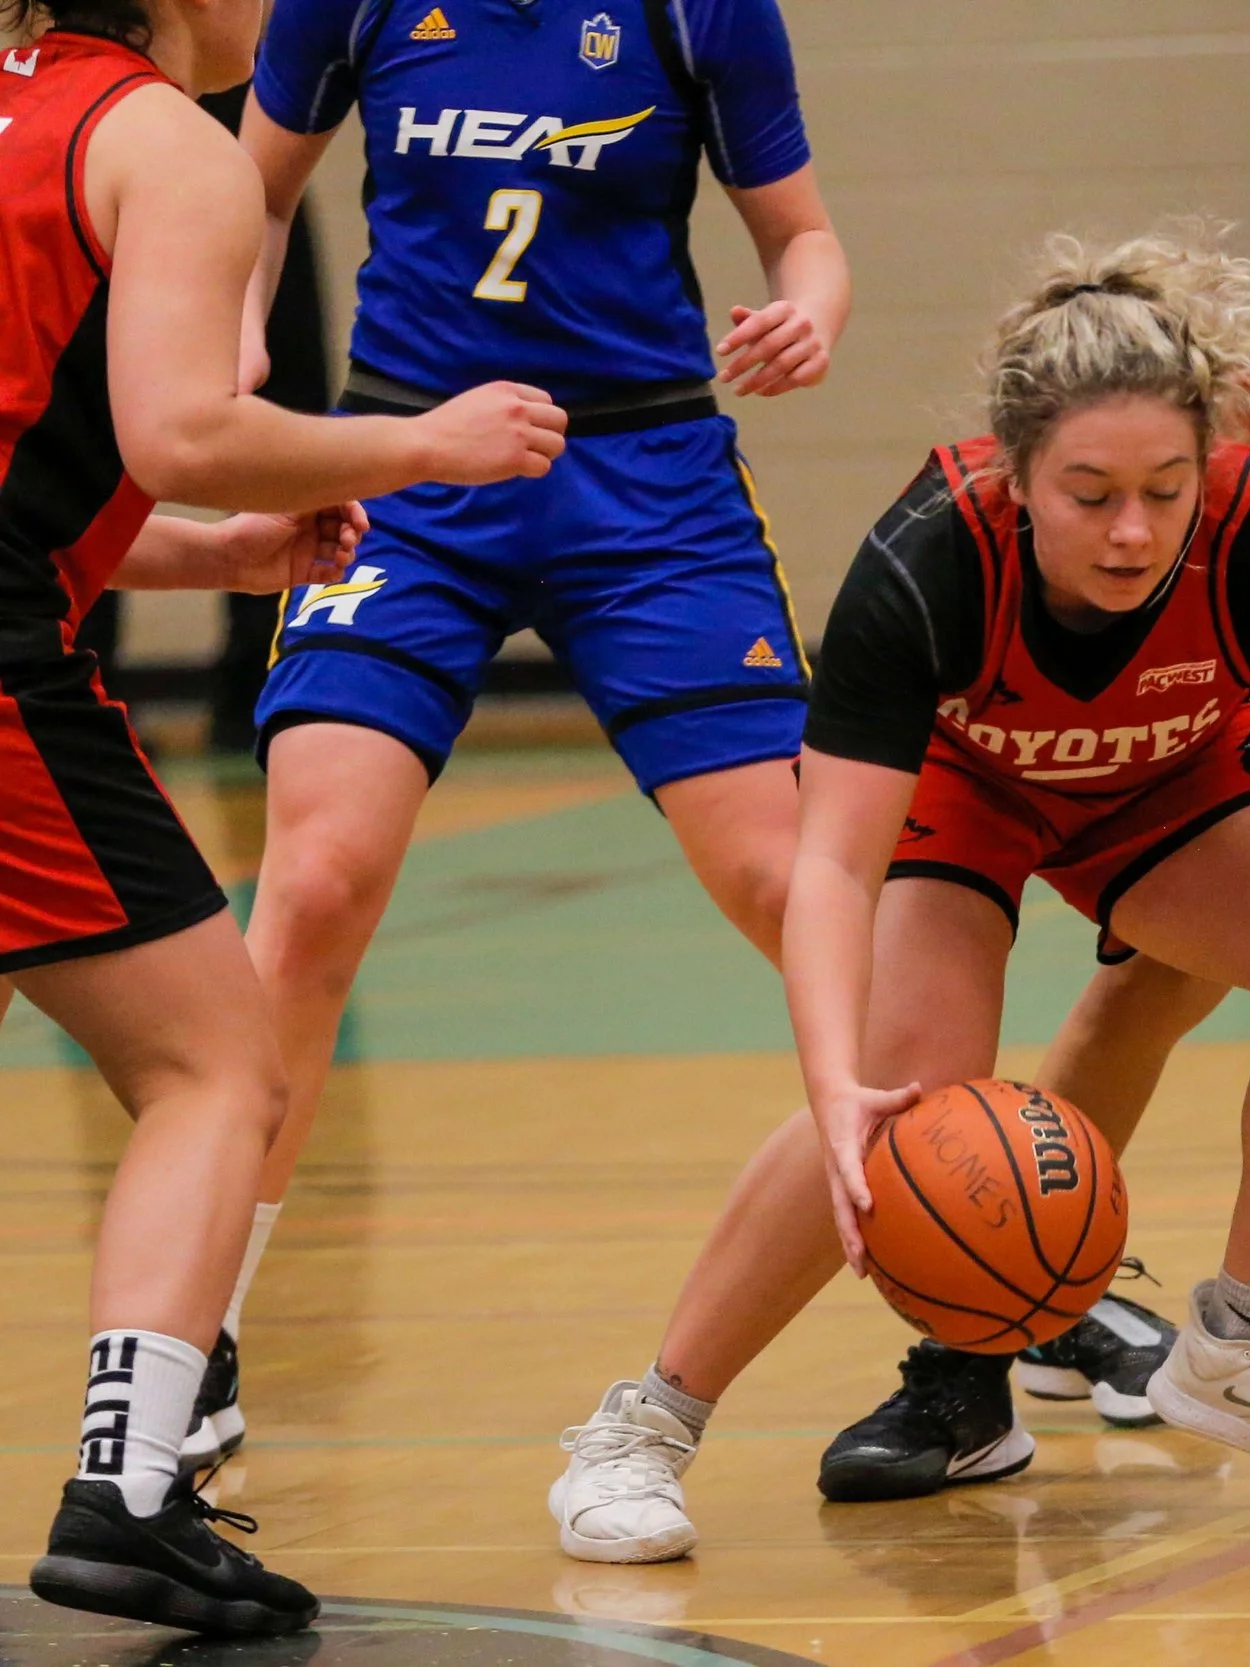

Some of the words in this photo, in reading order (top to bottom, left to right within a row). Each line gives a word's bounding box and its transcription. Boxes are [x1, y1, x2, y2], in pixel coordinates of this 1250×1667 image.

[409, 28, 457, 41] adidas
[584, 31, 616, 61] CW
[393, 104, 657, 171] HEAT
[471, 187, 544, 303] 2
